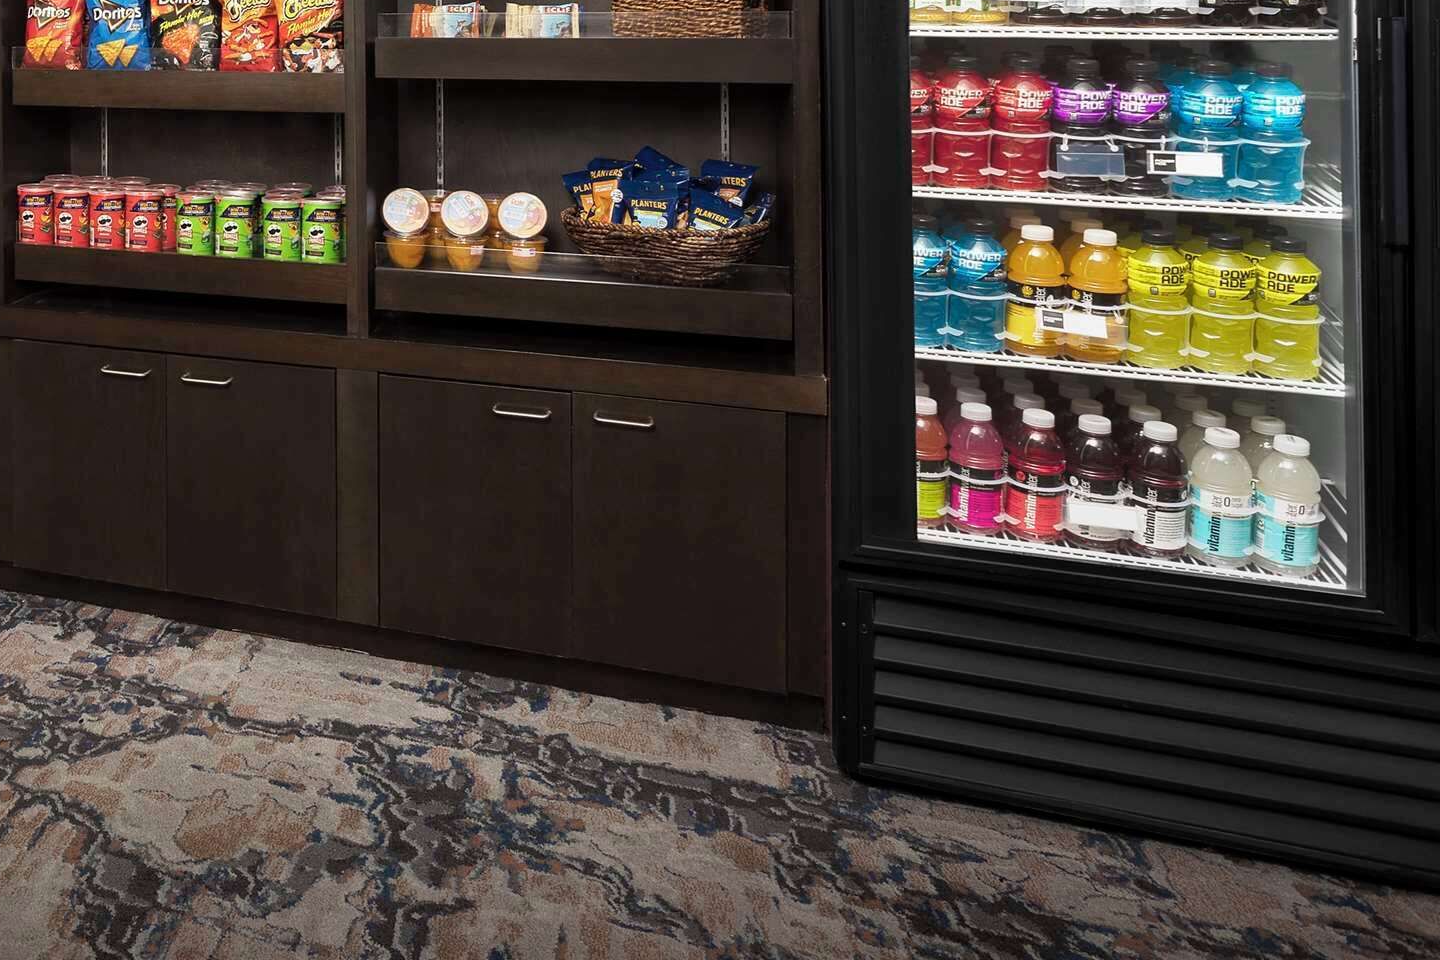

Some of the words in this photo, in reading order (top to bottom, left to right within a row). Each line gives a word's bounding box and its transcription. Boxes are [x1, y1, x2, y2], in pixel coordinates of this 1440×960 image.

[27, 6, 71, 19] Doritos
[93, 6, 142, 21] Doritos
[940, 88, 983, 99] POWER
[1119, 93, 1167, 103] POWER
[940, 97, 965, 107] ADE
[1018, 98, 1044, 109] ADE
[1080, 100, 1105, 110] ADE
[1119, 102, 1147, 113] ADE
[1204, 105, 1233, 115] ADE
[1276, 105, 1302, 115] ADE
[590, 168, 623, 179] PLANTERS
[631, 199, 667, 209] PLANTERS
[694, 207, 729, 225] PLANTERS
[959, 250, 1001, 262] POWER
[958, 258, 984, 269] ADE
[1161, 274, 1185, 284] ADE
[1268, 271, 1317, 284] POWER
[1219, 279, 1246, 289] ADE
[1267, 282, 1295, 293] ADE
